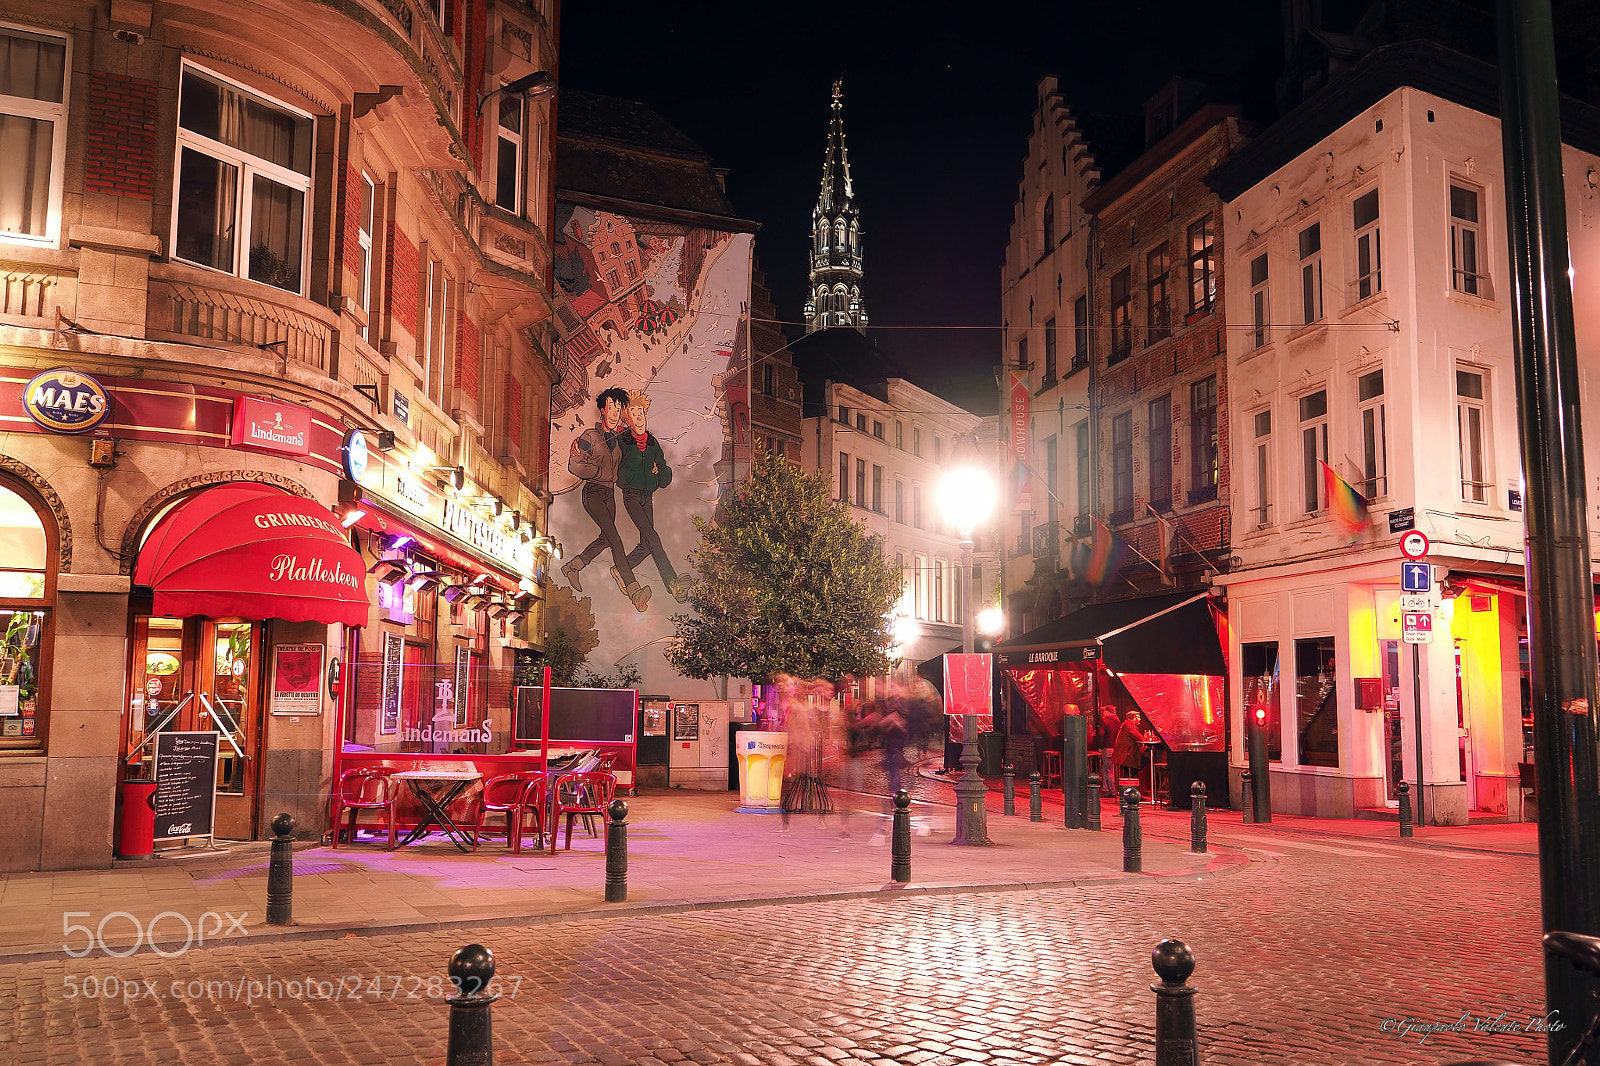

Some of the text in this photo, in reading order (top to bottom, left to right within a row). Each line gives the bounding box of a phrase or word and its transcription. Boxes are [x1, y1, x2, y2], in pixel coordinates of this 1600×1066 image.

[30, 386, 106, 414] MAES
[269, 554, 359, 588] Plattesteen
[1028, 651, 1059, 663] LE BAROQUE
